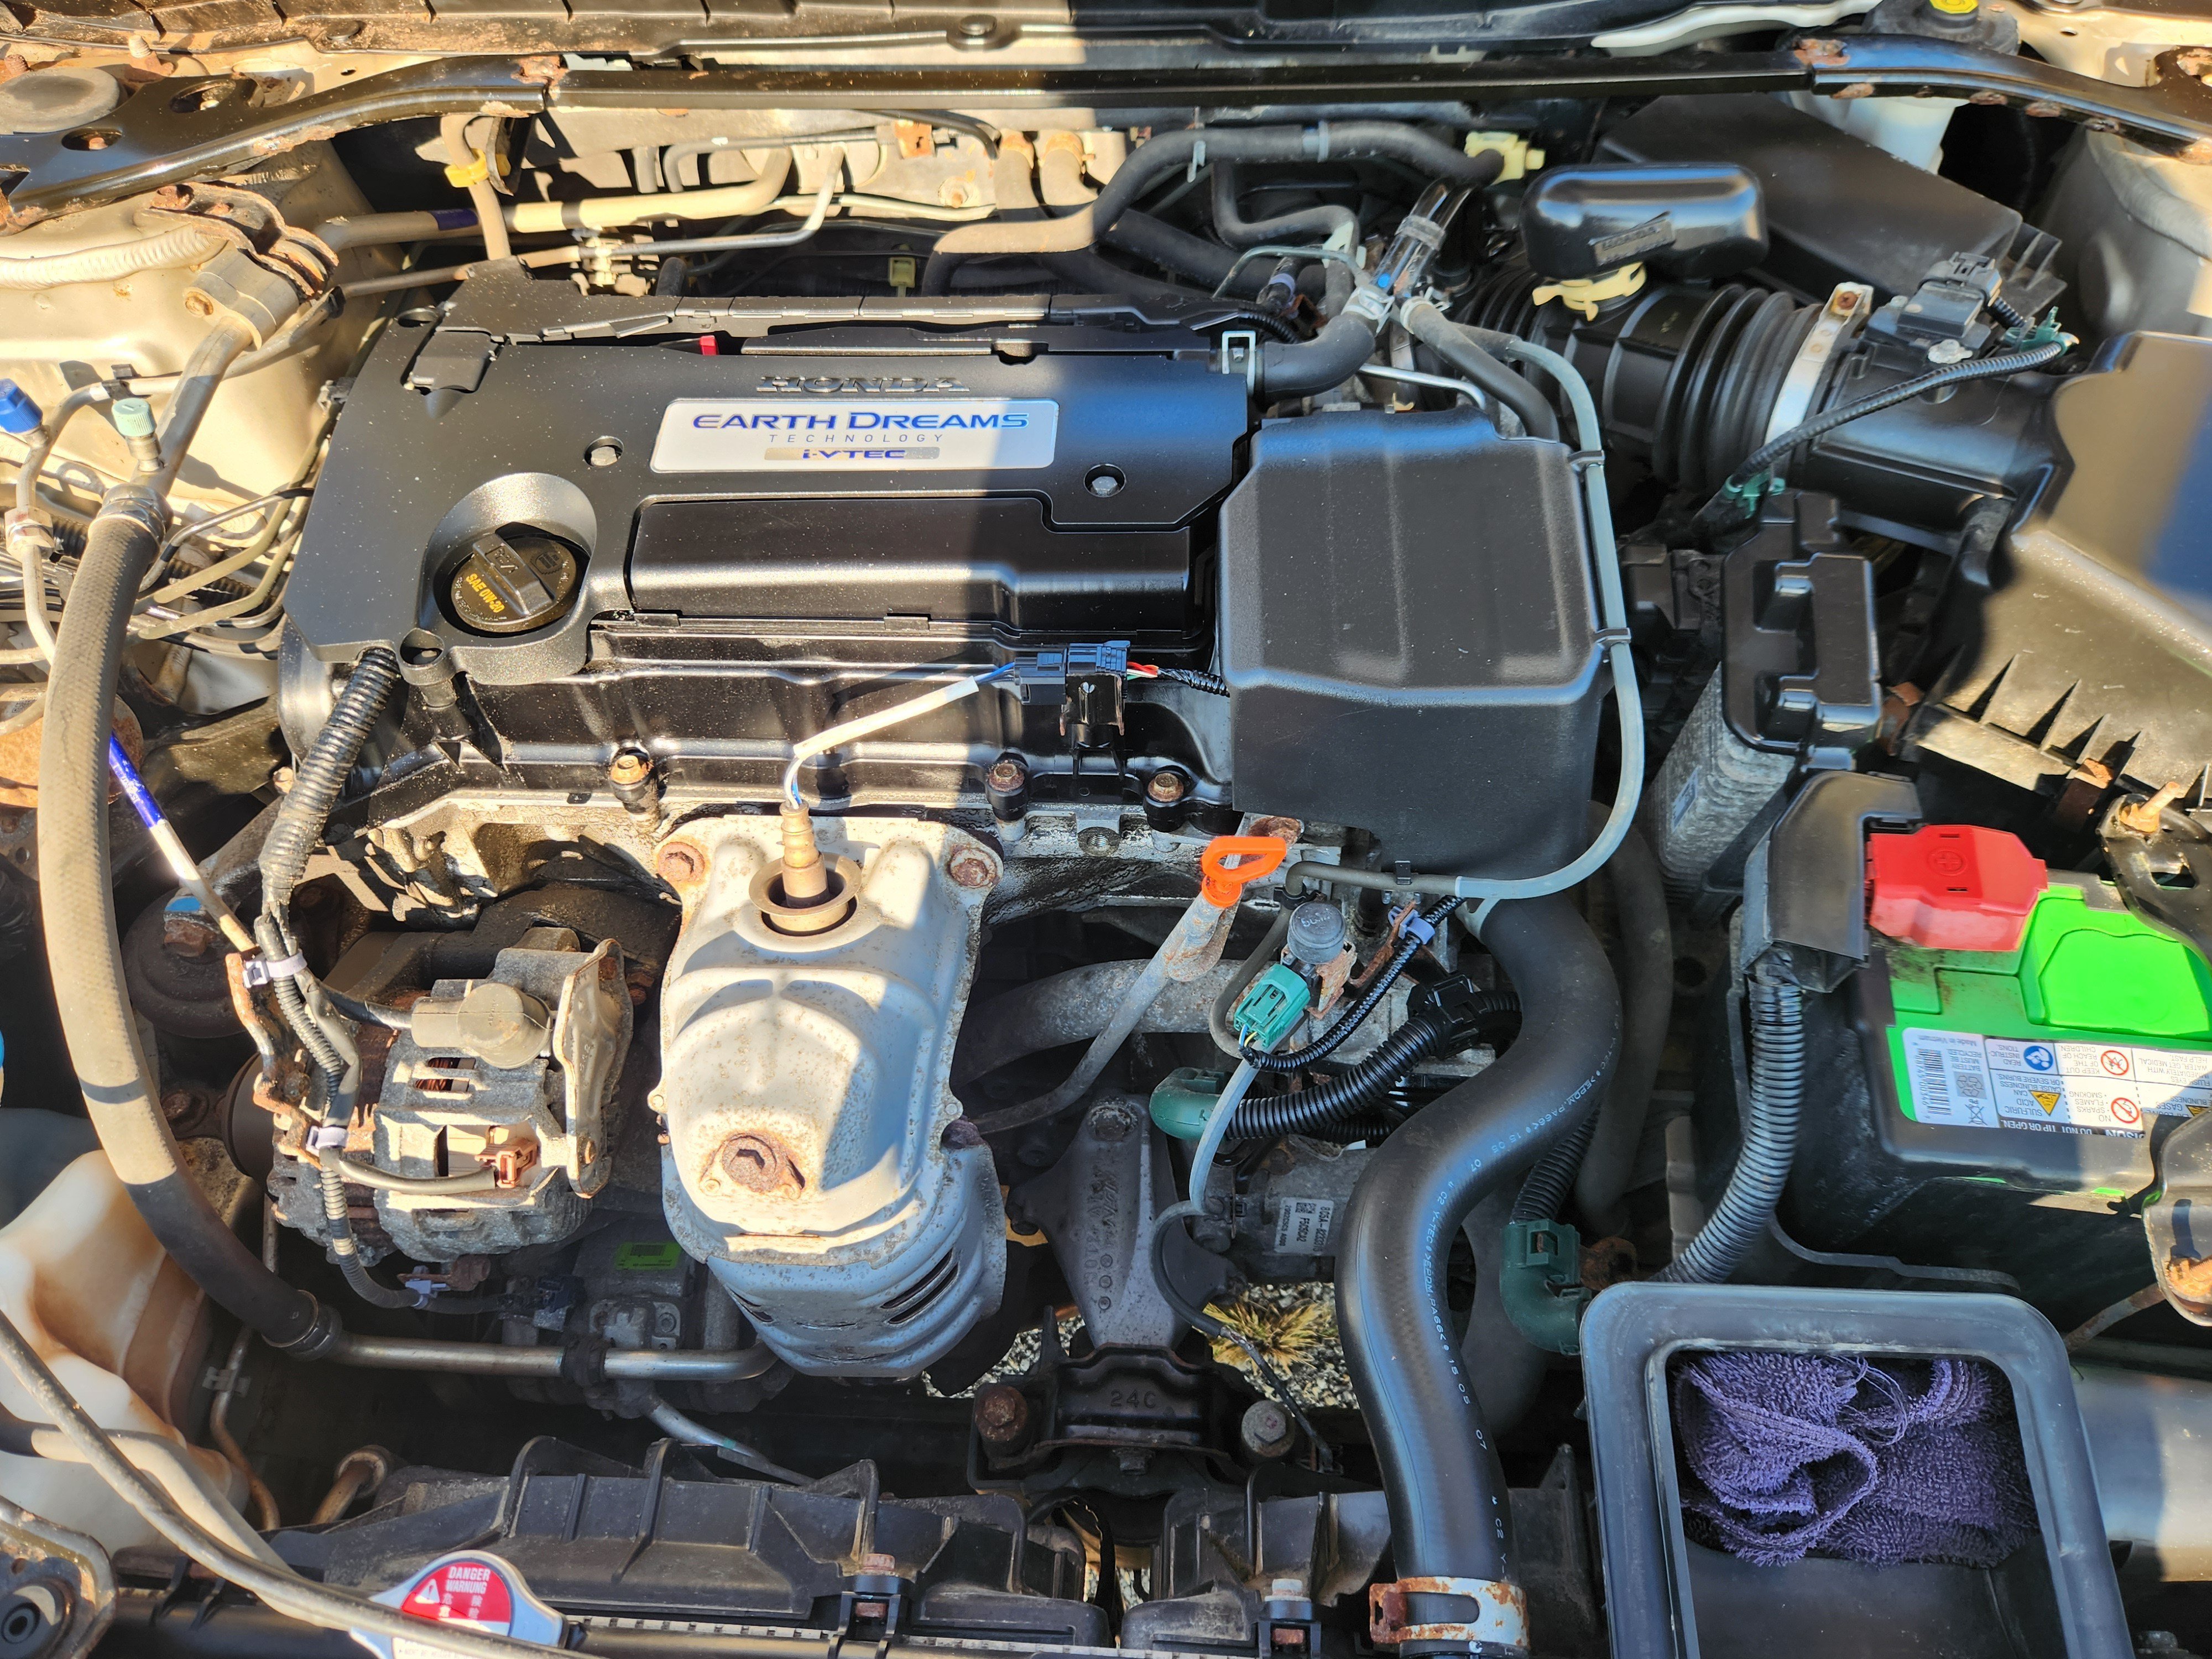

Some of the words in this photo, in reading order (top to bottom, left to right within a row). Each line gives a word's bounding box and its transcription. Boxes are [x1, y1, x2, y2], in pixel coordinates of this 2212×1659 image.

[757, 376, 970, 393] HONDA
[692, 413, 836, 430] EARTH
[849, 411, 1030, 429] DREAMS
[769, 434, 944, 443] TECHNOLOGY
[802, 449, 906, 458] i-VTEC
[466, 573, 487, 592] SAE
[479, 588, 505, 613] 0W-20
[2138, 1058, 2168, 1067] MEDICAL
[2000, 1081, 2037, 1090] BLINDNESS
[2004, 1106, 2042, 1116] SULFURIC
[2156, 1102, 2183, 1111] GASES
[2028, 1123, 2041, 1131] OR
[2043, 1124, 2056, 1133] TIP
[1427, 1211, 1439, 1243] Y-TEC
[1449, 1360, 1459, 1375] 15
[1459, 1384, 1470, 1405] 05
[1476, 1430, 1487, 1450] 07
[1495, 1518, 1504, 1538] C2
[448, 1566, 491, 1581] DANGER
[446, 1579, 488, 1594] WARNUNG
